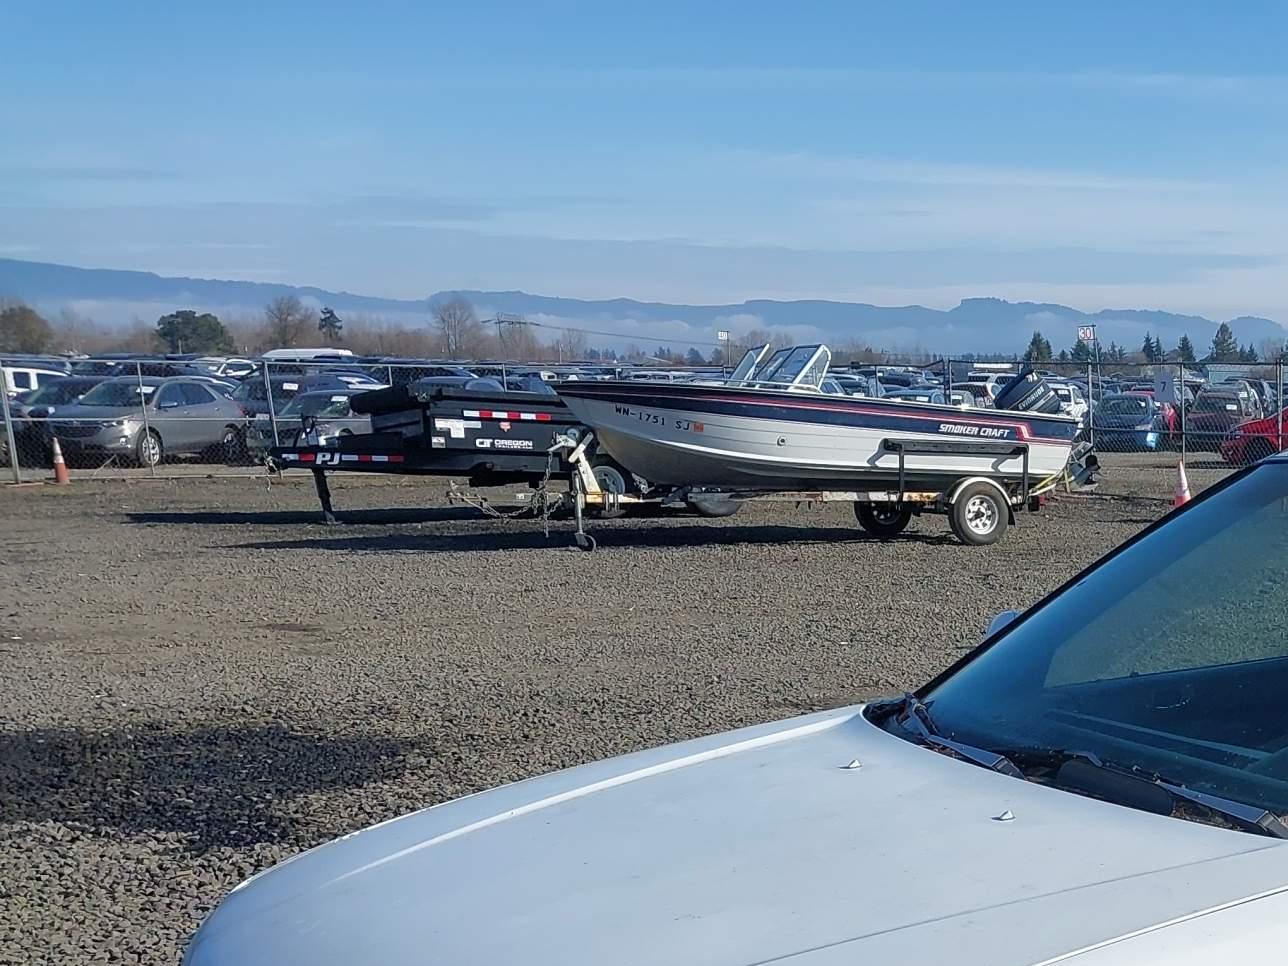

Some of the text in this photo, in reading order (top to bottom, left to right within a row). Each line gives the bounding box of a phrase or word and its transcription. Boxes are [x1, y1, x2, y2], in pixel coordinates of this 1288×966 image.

[1079, 328, 1092, 339] 30
[1160, 381, 1167, 392] 7
[675, 420, 690, 431] SJ
[938, 423, 1010, 438] SMOKER CRAFT
[316, 452, 340, 465] PJ
